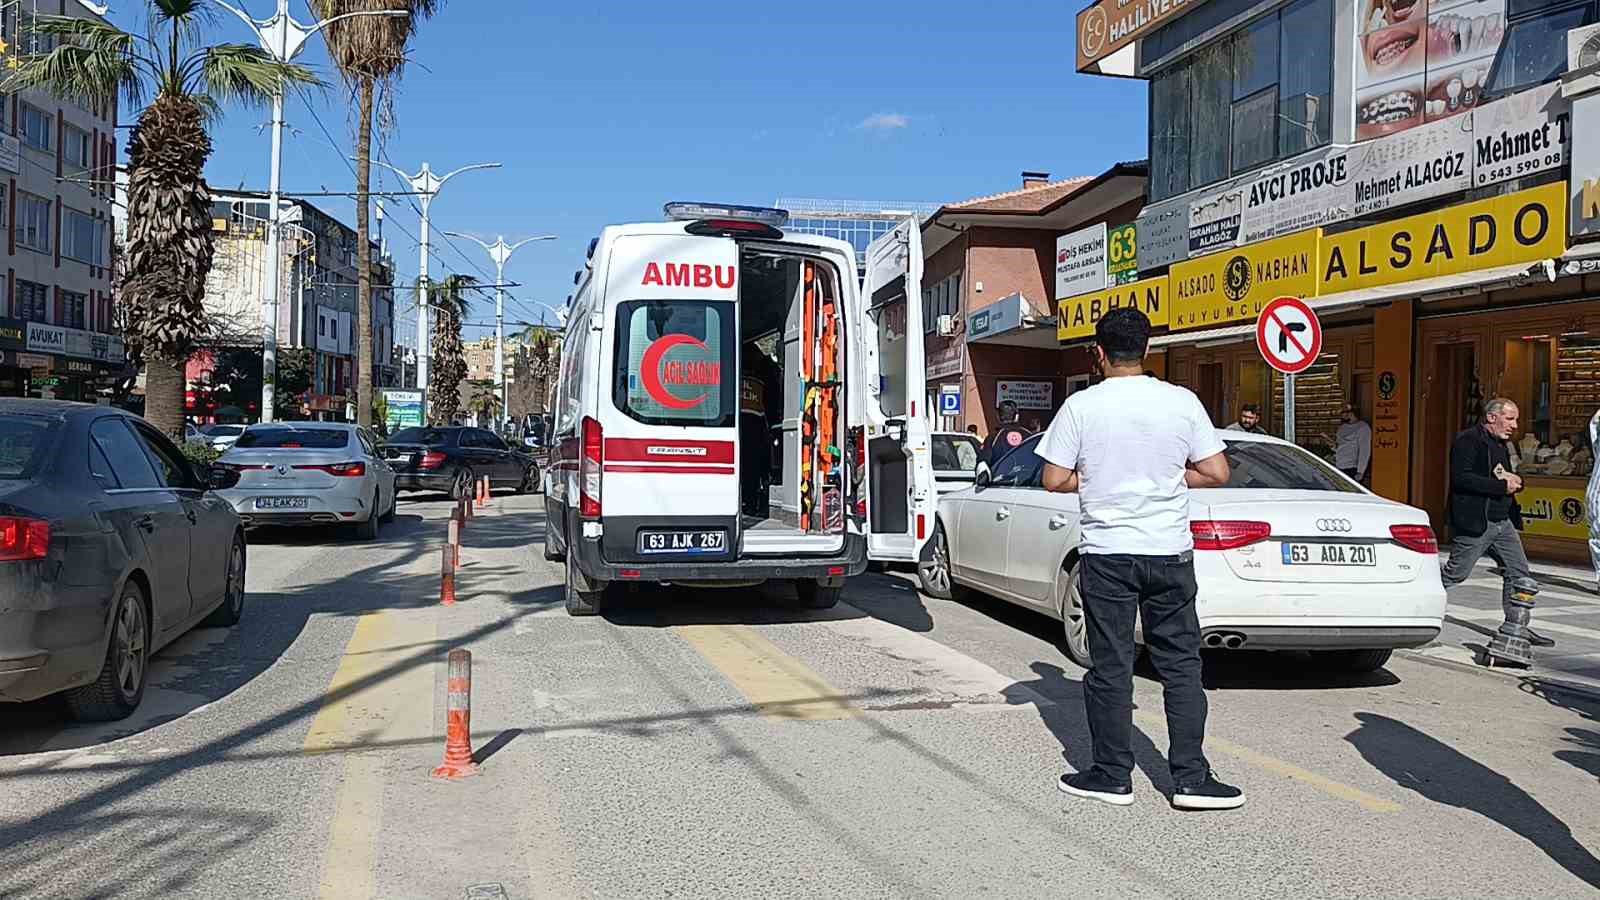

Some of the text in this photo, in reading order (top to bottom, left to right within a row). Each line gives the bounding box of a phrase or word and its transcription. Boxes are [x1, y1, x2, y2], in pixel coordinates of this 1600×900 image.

[1476, 121, 1550, 168] Mehmet
[1248, 154, 1347, 208] AVCI PROJE
[1355, 151, 1464, 203] Mehmet ALAGÖZ
[1478, 152, 1561, 184] 0 543 590 08
[1110, 227, 1136, 262] 63
[1200, 231, 1232, 246] ALAGÖZ
[1324, 202, 1549, 282] ALSADO
[641, 262, 735, 289] AMBU
[1257, 253, 1308, 283] NABHAN
[1178, 273, 1215, 299] ALSADO
[1059, 286, 1160, 329] NABHAN
[30, 327, 63, 345] AVUKAT
[944, 395, 957, 410] D
[650, 533, 722, 548] 63 AJK 267
[1291, 545, 1309, 562] 63
[1349, 546, 1373, 563] 201
